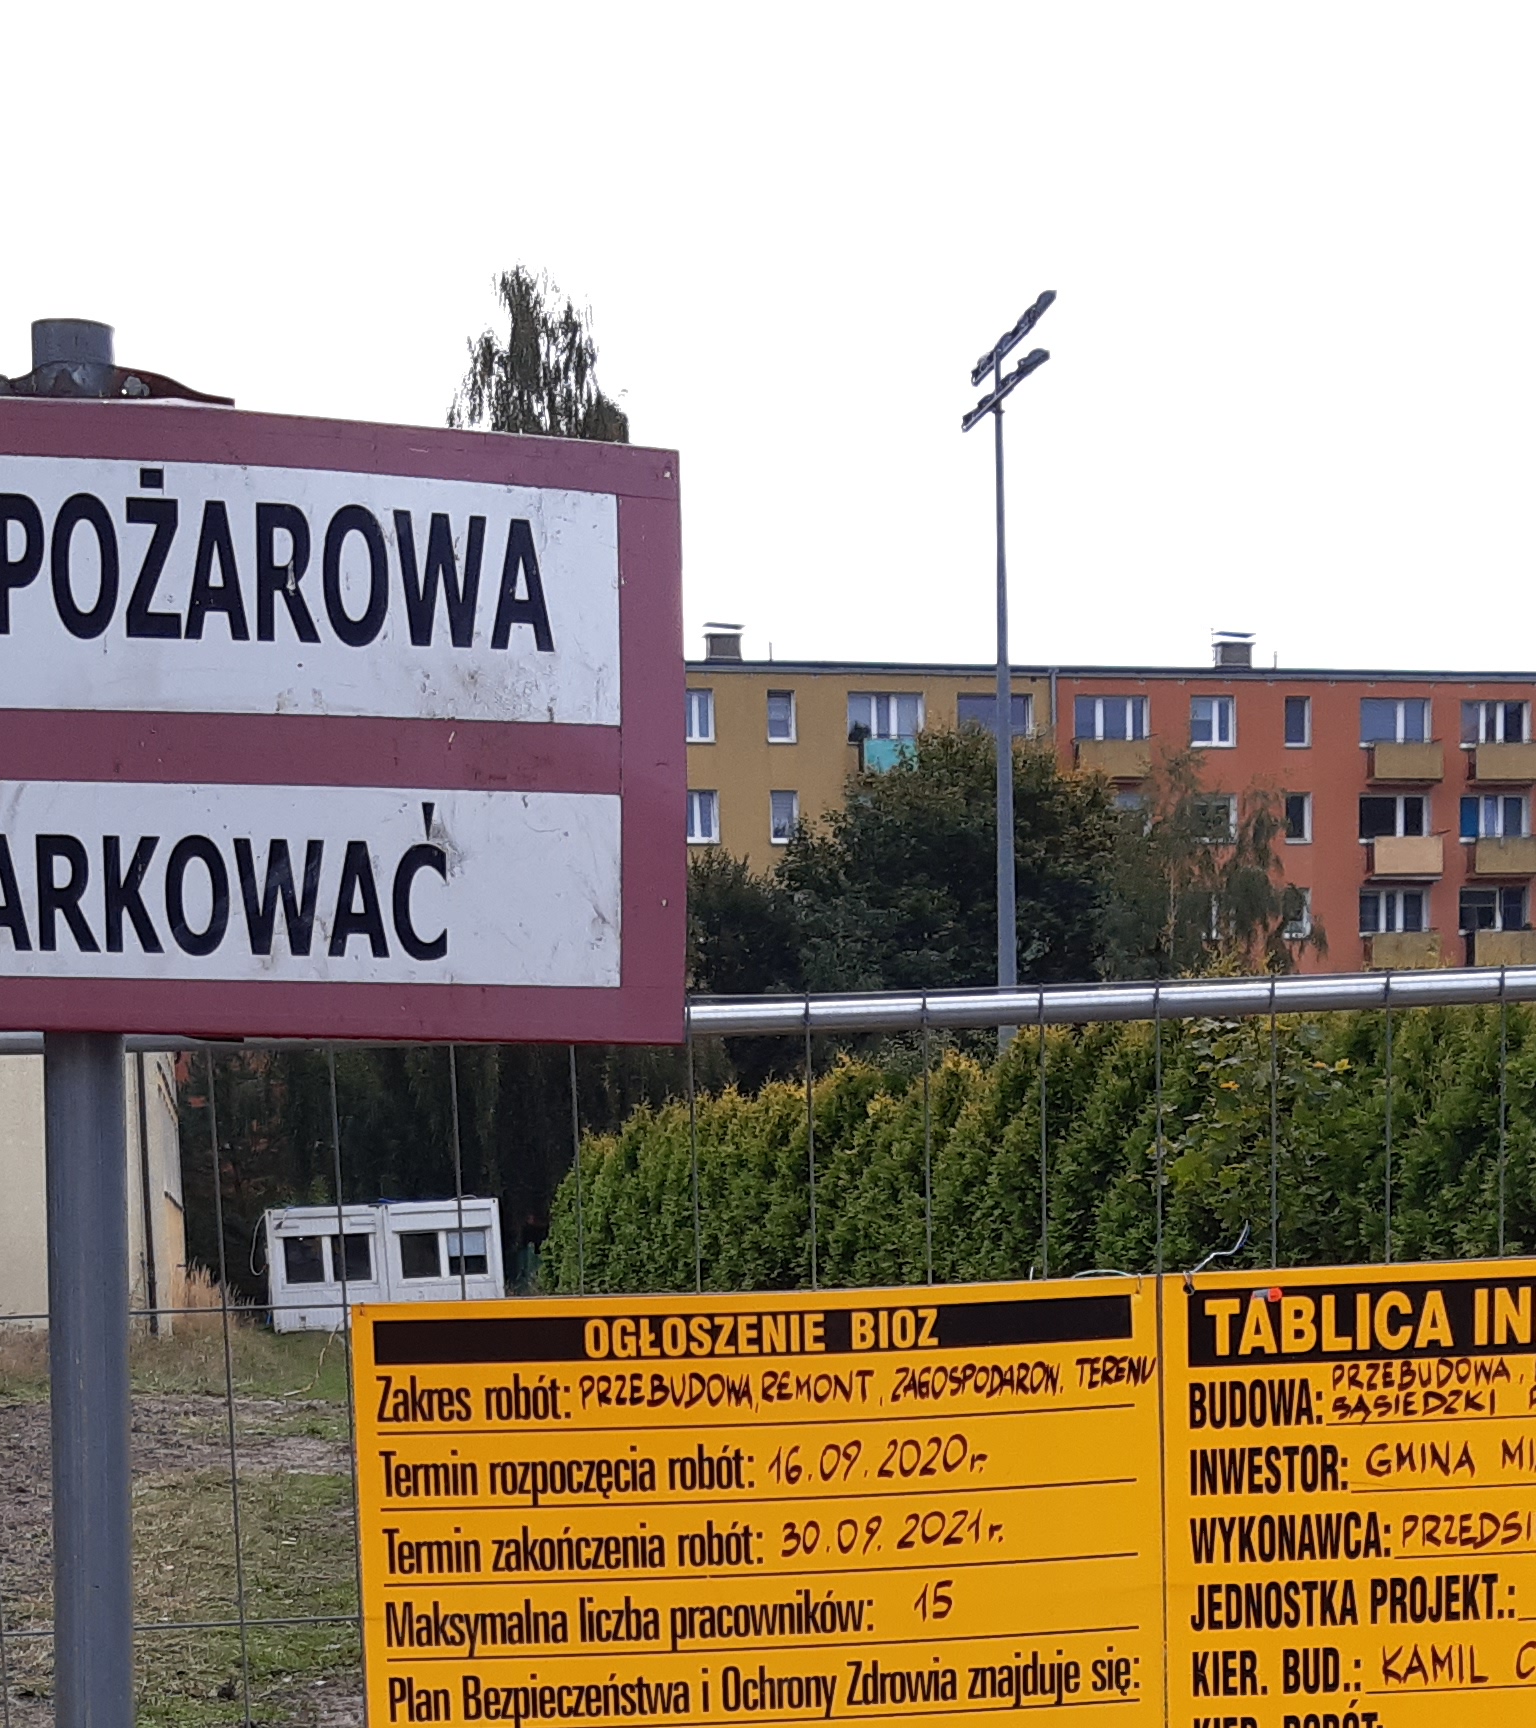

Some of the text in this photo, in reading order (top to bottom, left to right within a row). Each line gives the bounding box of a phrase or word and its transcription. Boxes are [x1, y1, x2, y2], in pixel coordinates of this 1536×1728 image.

[584, 1309, 939, 1359] OGŁOSZENIE BIOZ
[1204, 1293, 1456, 1356] TABLICA
[376, 1374, 471, 1423] Zakres
[486, 1373, 571, 1419] robót:
[1076, 1356, 1156, 1388] TERENU
[1189, 1378, 1322, 1430] BUDOWA:
[381, 1449, 478, 1499] Termin
[490, 1444, 656, 1507] rozpoczęcia
[668, 1444, 755, 1490] robót:
[1190, 1443, 1348, 1496] INWESTOR:
[1366, 1441, 1476, 1479] GMINA
[384, 1526, 482, 1575] Termin
[492, 1521, 665, 1572] zakończenia
[677, 1519, 763, 1566] robót:
[1190, 1511, 1391, 1564] WYKONAWCA:
[386, 1580, 954, 1658] Maksymalna liczba pracowników: 15
[1191, 1577, 1358, 1632] JEDNOSTKA
[1371, 1573, 1516, 1624] PROJEKT.:
[389, 1647, 1140, 1728] Plan Bezpieczeństwa i Ochrony Zdrowia znajduje się:
[1193, 1650, 1267, 1698] KIER.
[1282, 1645, 1362, 1695] BUD.:
[1382, 1641, 1488, 1685] KAMIL
